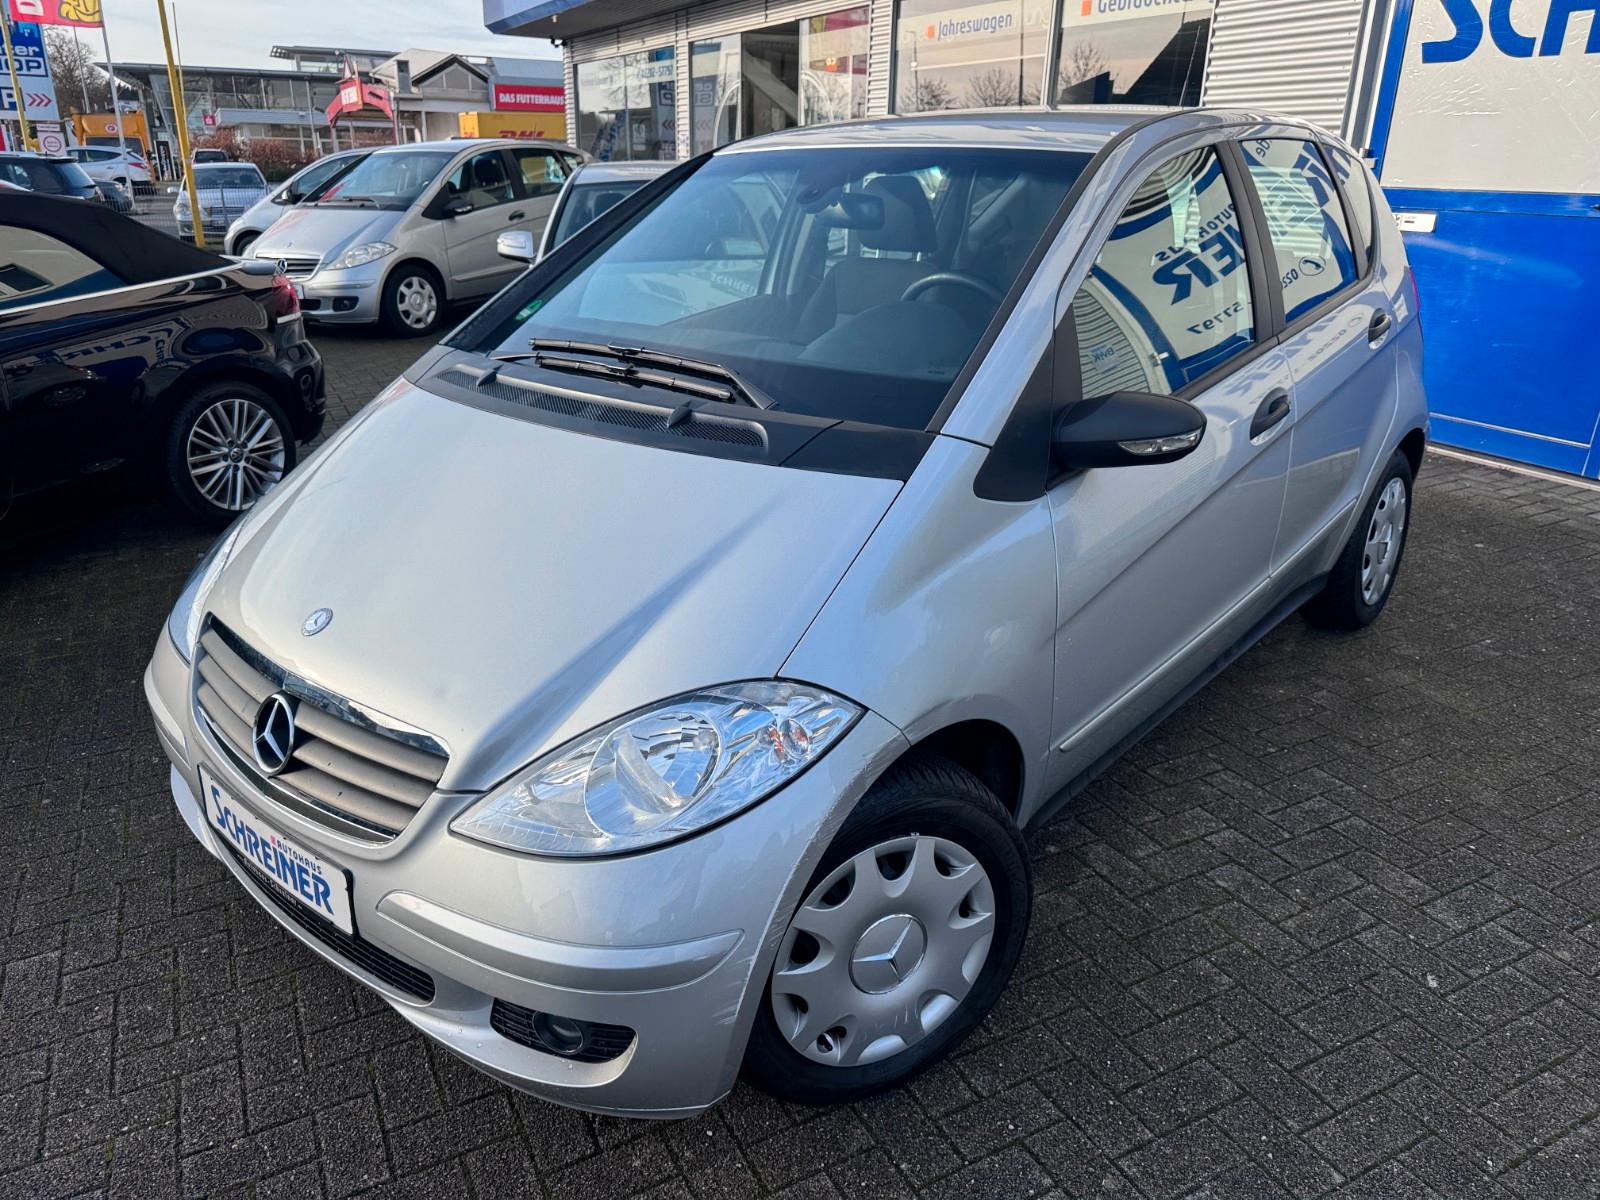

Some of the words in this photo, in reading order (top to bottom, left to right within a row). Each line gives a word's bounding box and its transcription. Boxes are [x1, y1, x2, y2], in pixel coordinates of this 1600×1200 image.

[937, 13, 1013, 41] Jahreswagen
[499, 92, 516, 103] DAS
[516, 94, 565, 105] FUTTERHAUS
[210, 784, 335, 916] SCHREINER
[277, 839, 322, 875] AUTOHAUS
